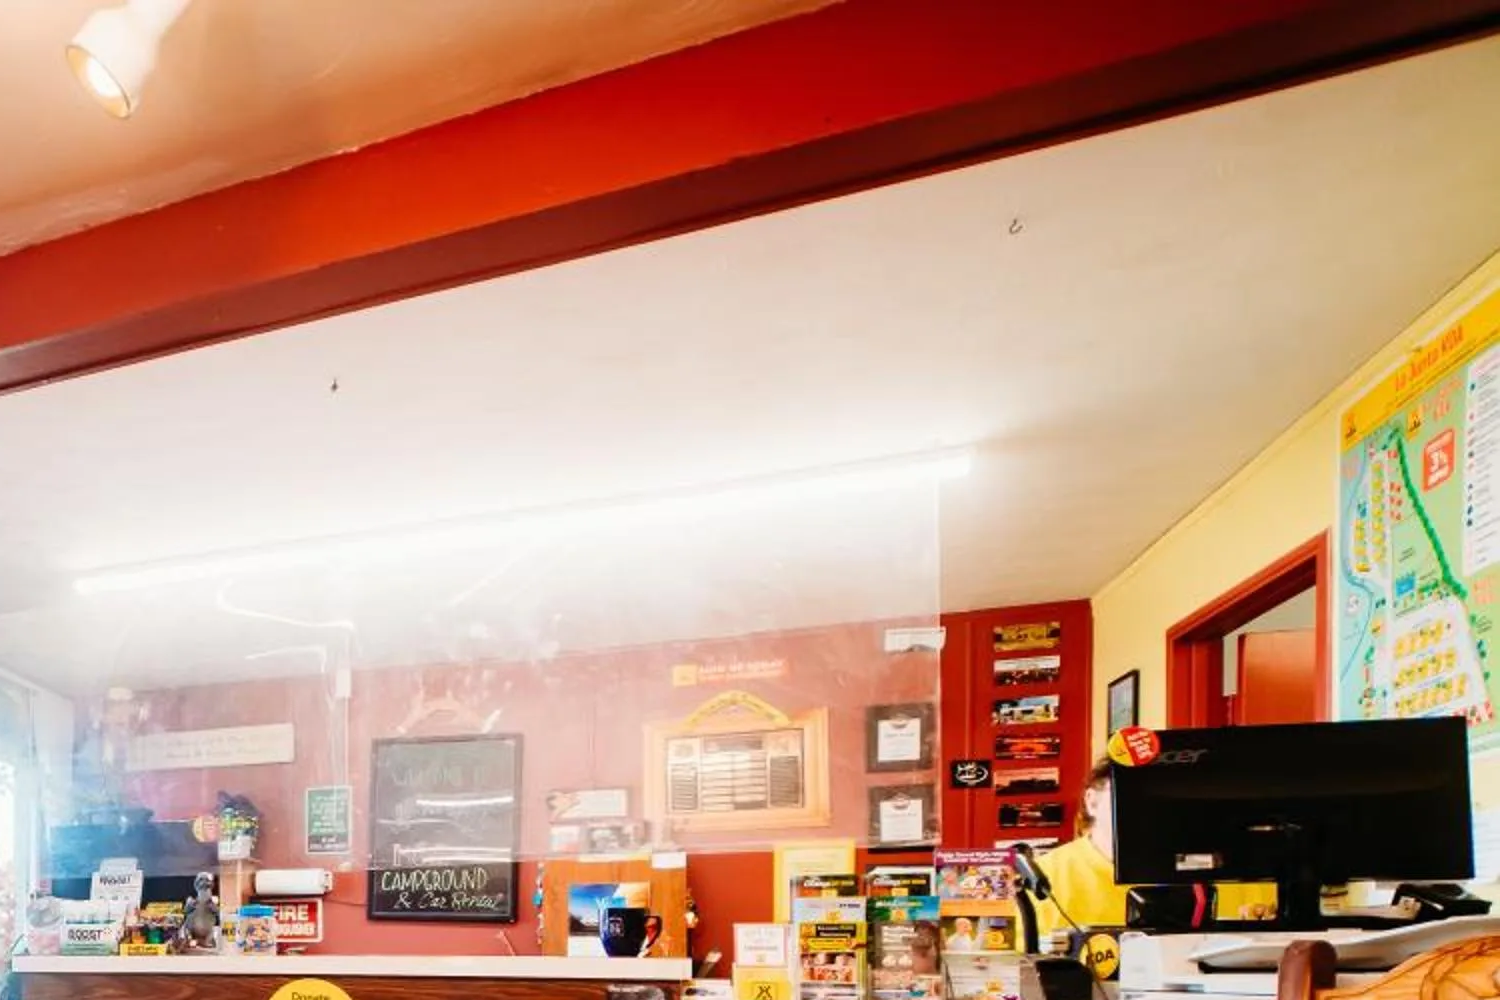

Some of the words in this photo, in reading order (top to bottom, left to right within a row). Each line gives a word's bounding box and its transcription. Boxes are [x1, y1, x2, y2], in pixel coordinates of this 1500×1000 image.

[381, 868, 488, 893] CAMPGROUND
[393, 891, 412, 909] &
[418, 891, 448, 910] Car
